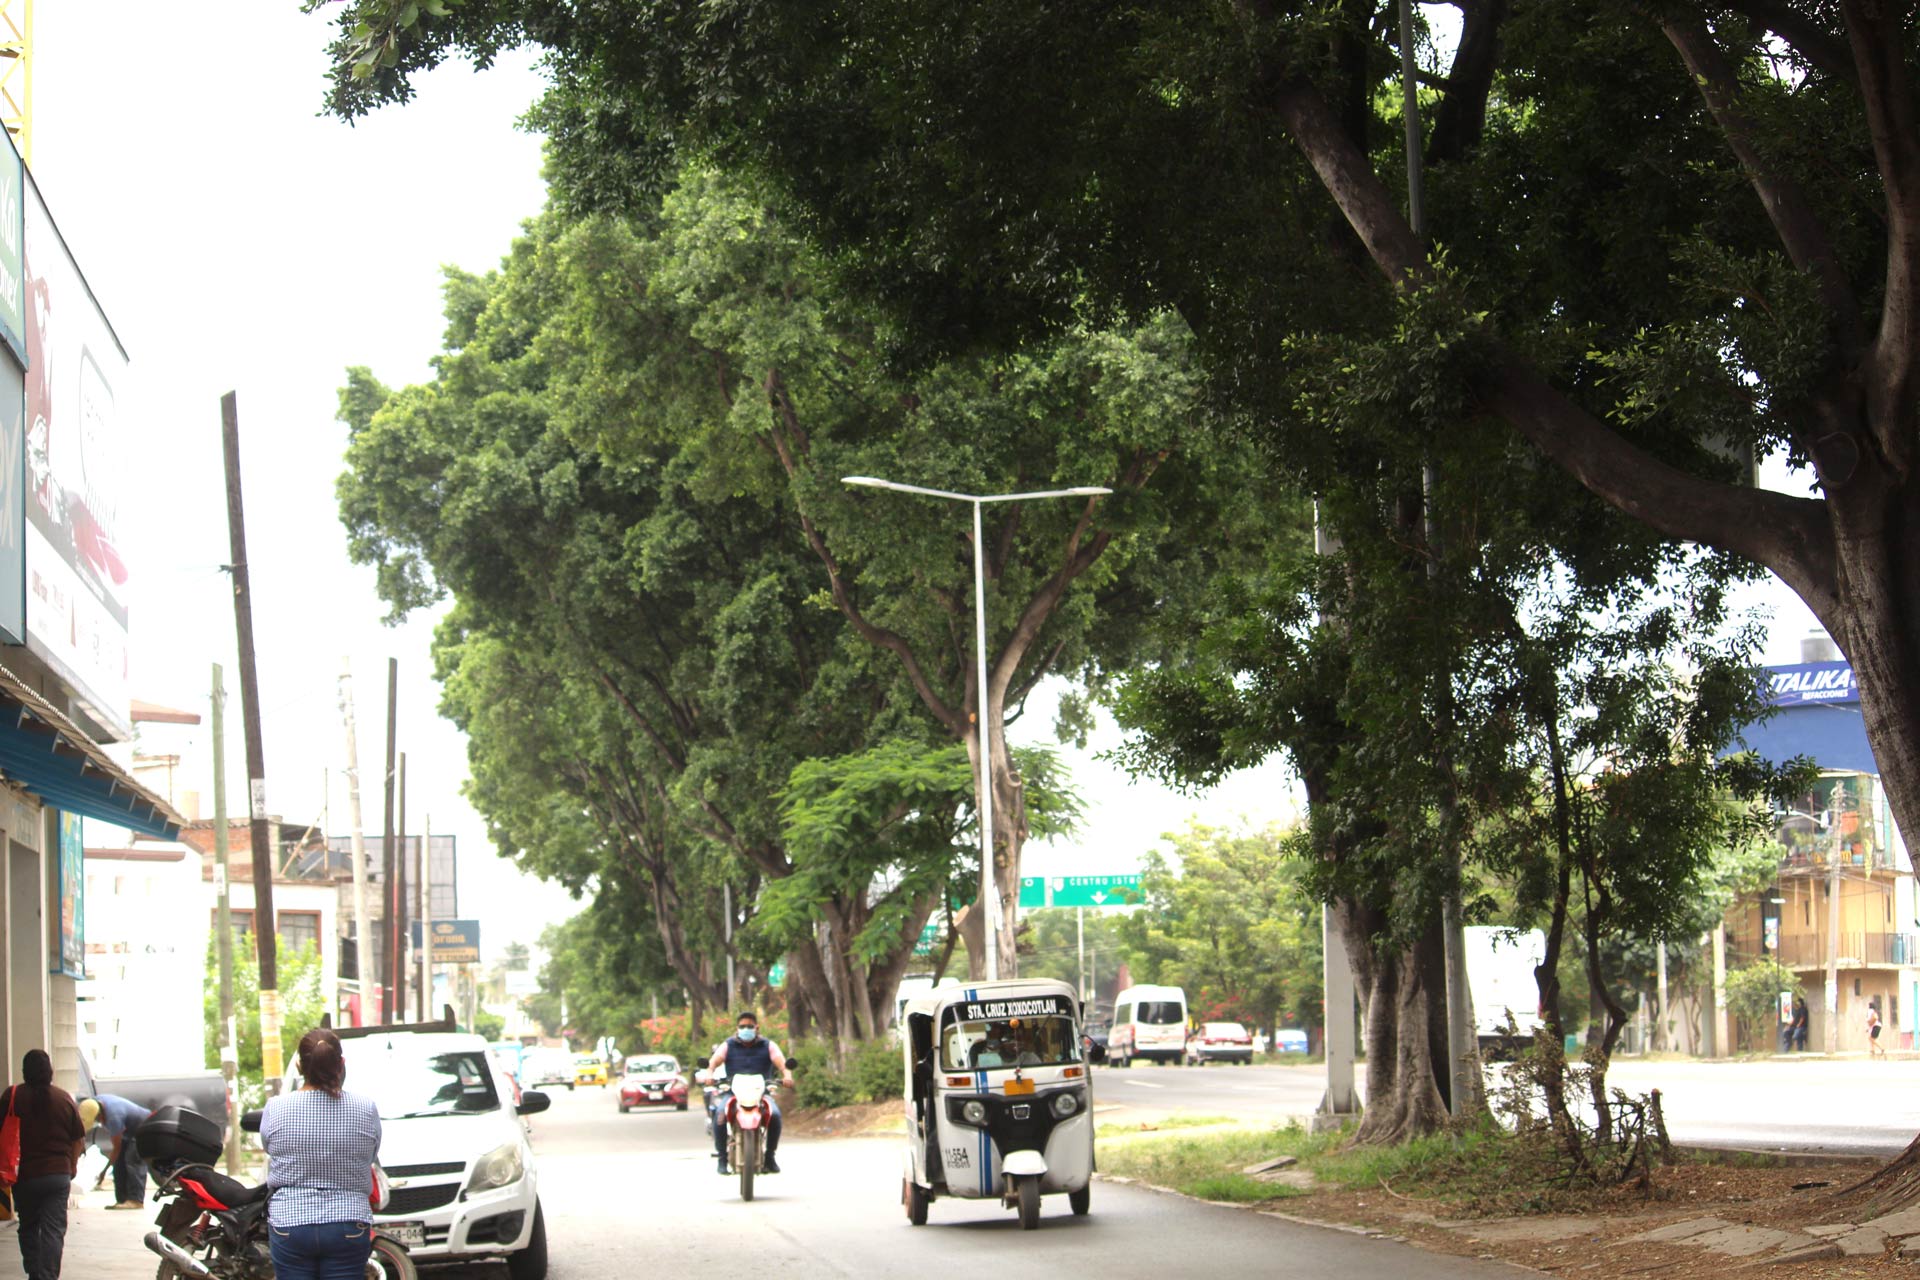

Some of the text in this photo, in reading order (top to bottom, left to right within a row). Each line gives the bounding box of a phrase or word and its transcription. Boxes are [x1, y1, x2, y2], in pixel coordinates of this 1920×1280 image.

[1802, 689, 1849, 701] REFACCIONES
[1069, 877, 1109, 886] CENTRO
[967, 999, 1057, 1020] STA. CRUZ XOXOCOTLAN
